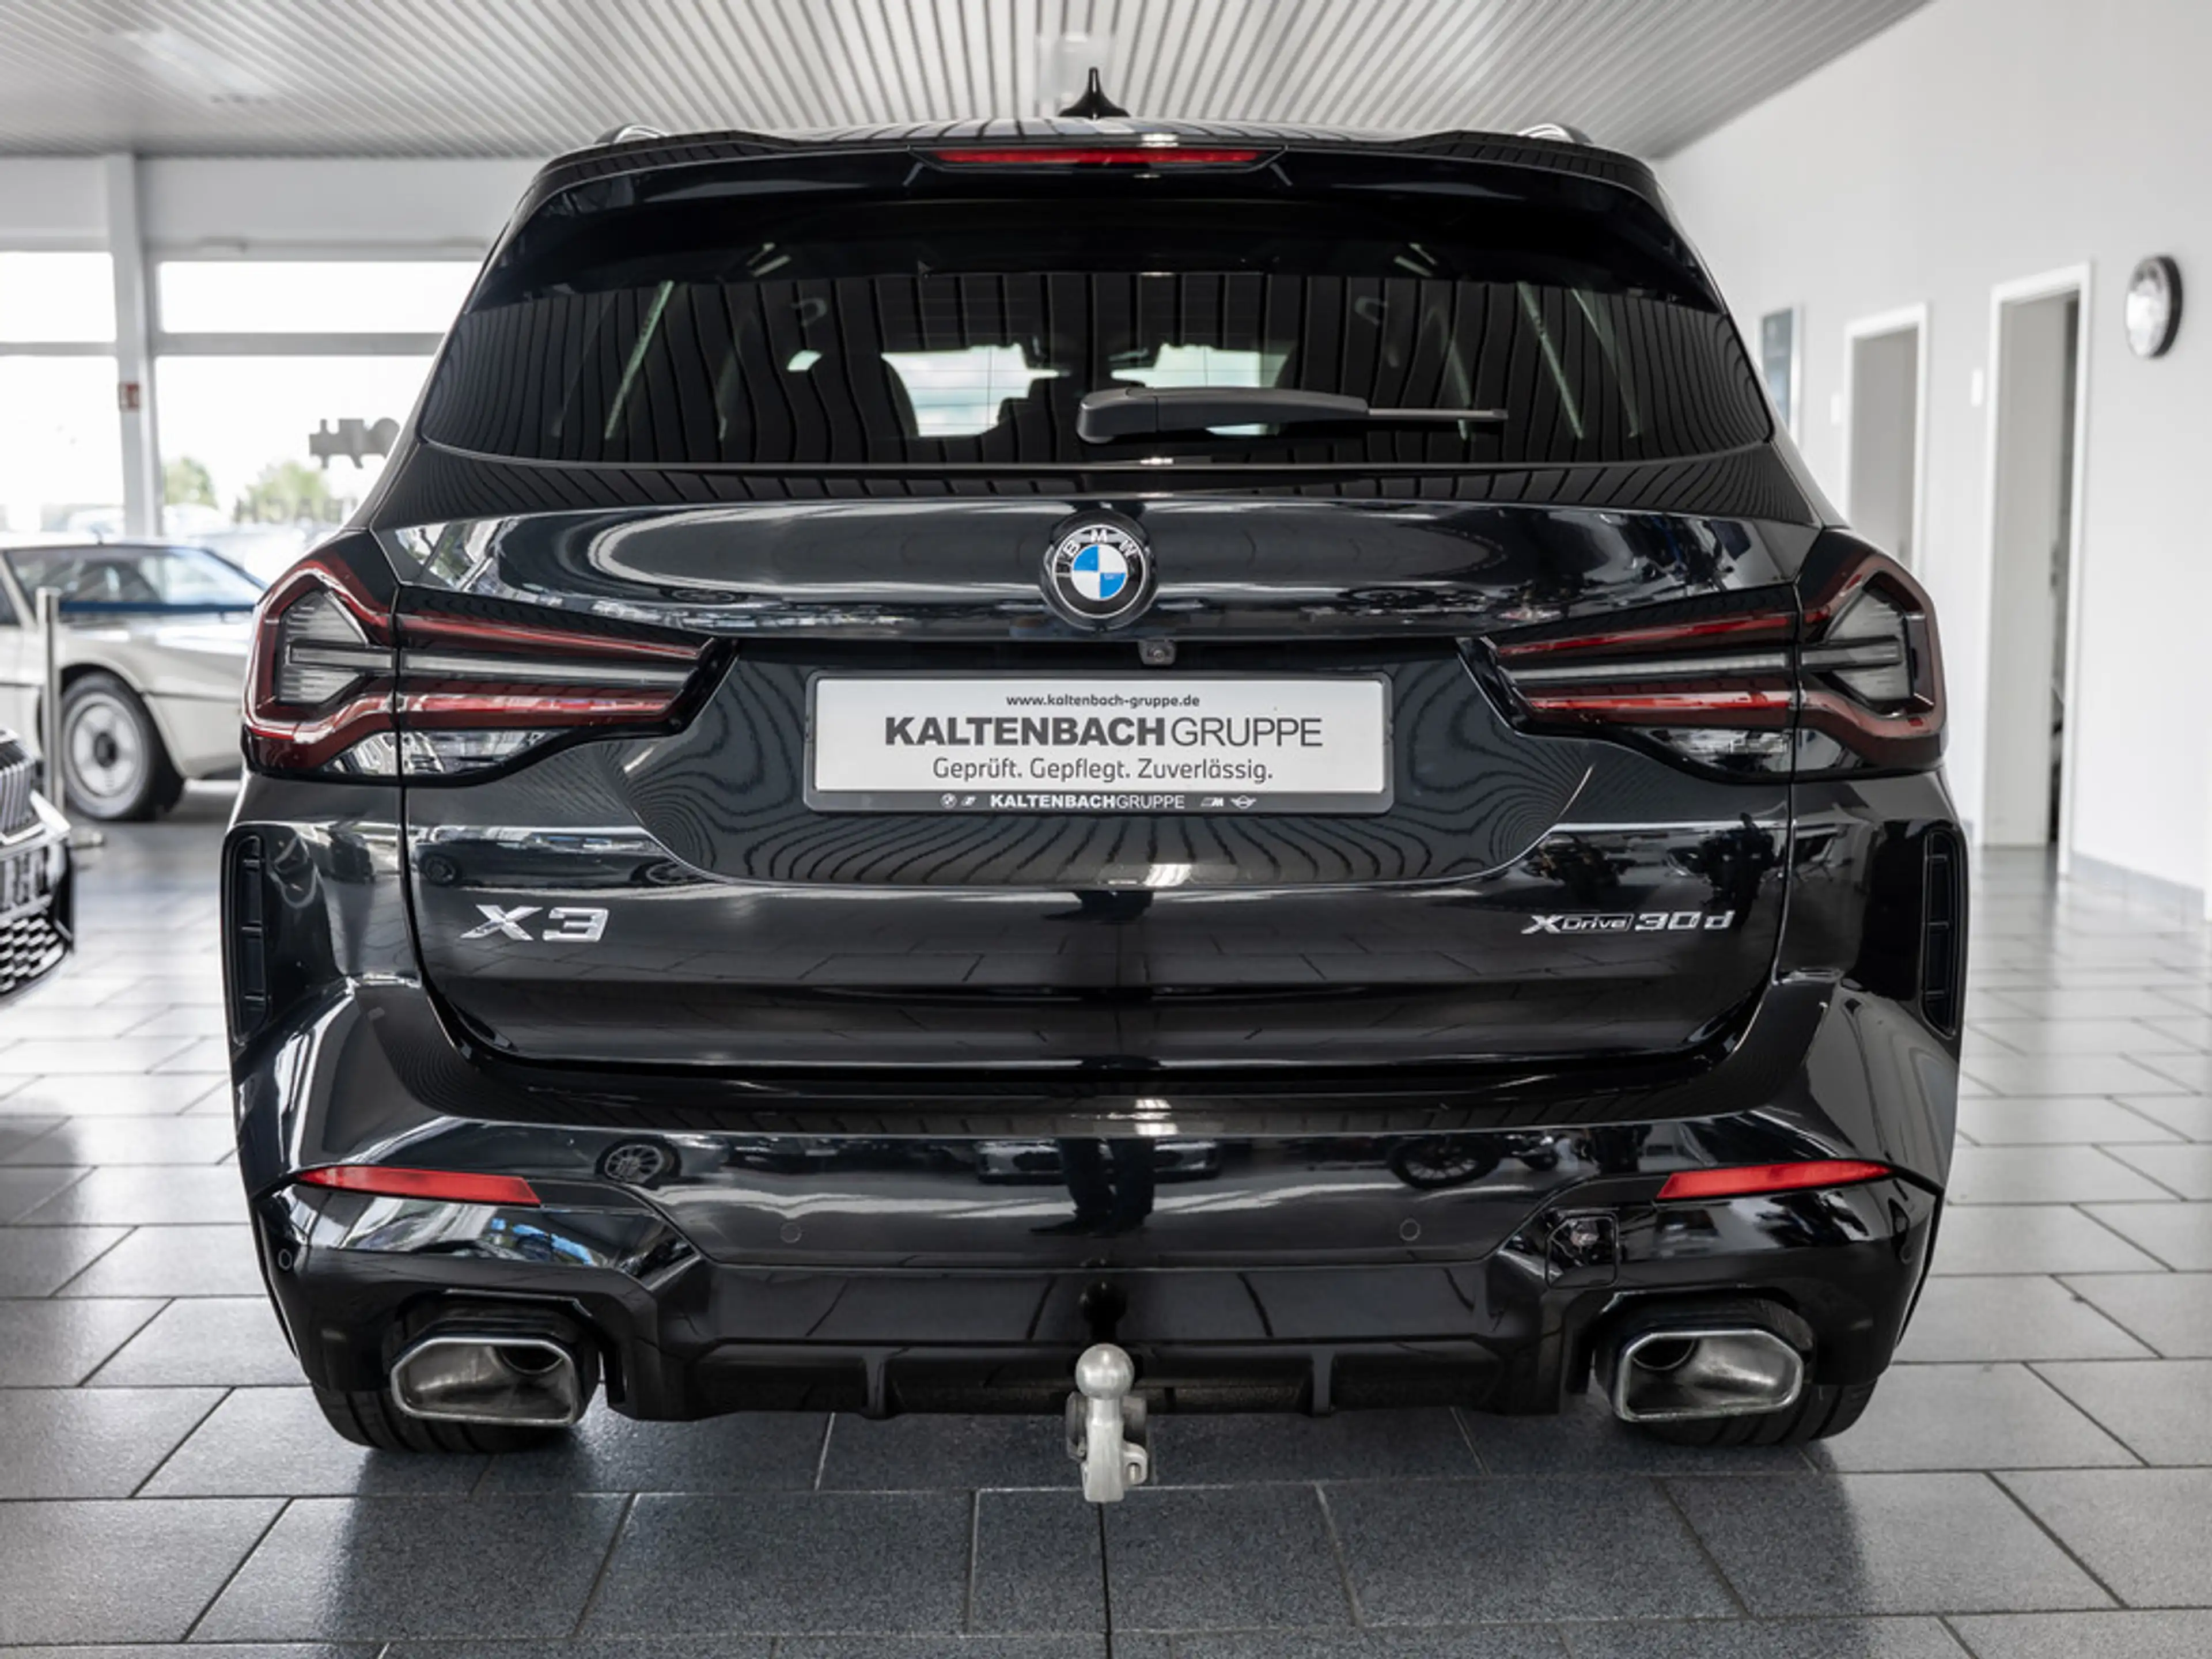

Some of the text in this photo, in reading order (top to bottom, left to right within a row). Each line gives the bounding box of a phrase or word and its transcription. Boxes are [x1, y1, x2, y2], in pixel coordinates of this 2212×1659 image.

[1063, 529, 1139, 558] BMW
[1006, 694, 1200, 708] www.kaltenbach-gruppe.de
[933, 757, 1273, 783] Geprüft. Gepflegt. Zuverlässig.
[460, 904, 609, 941] X3
